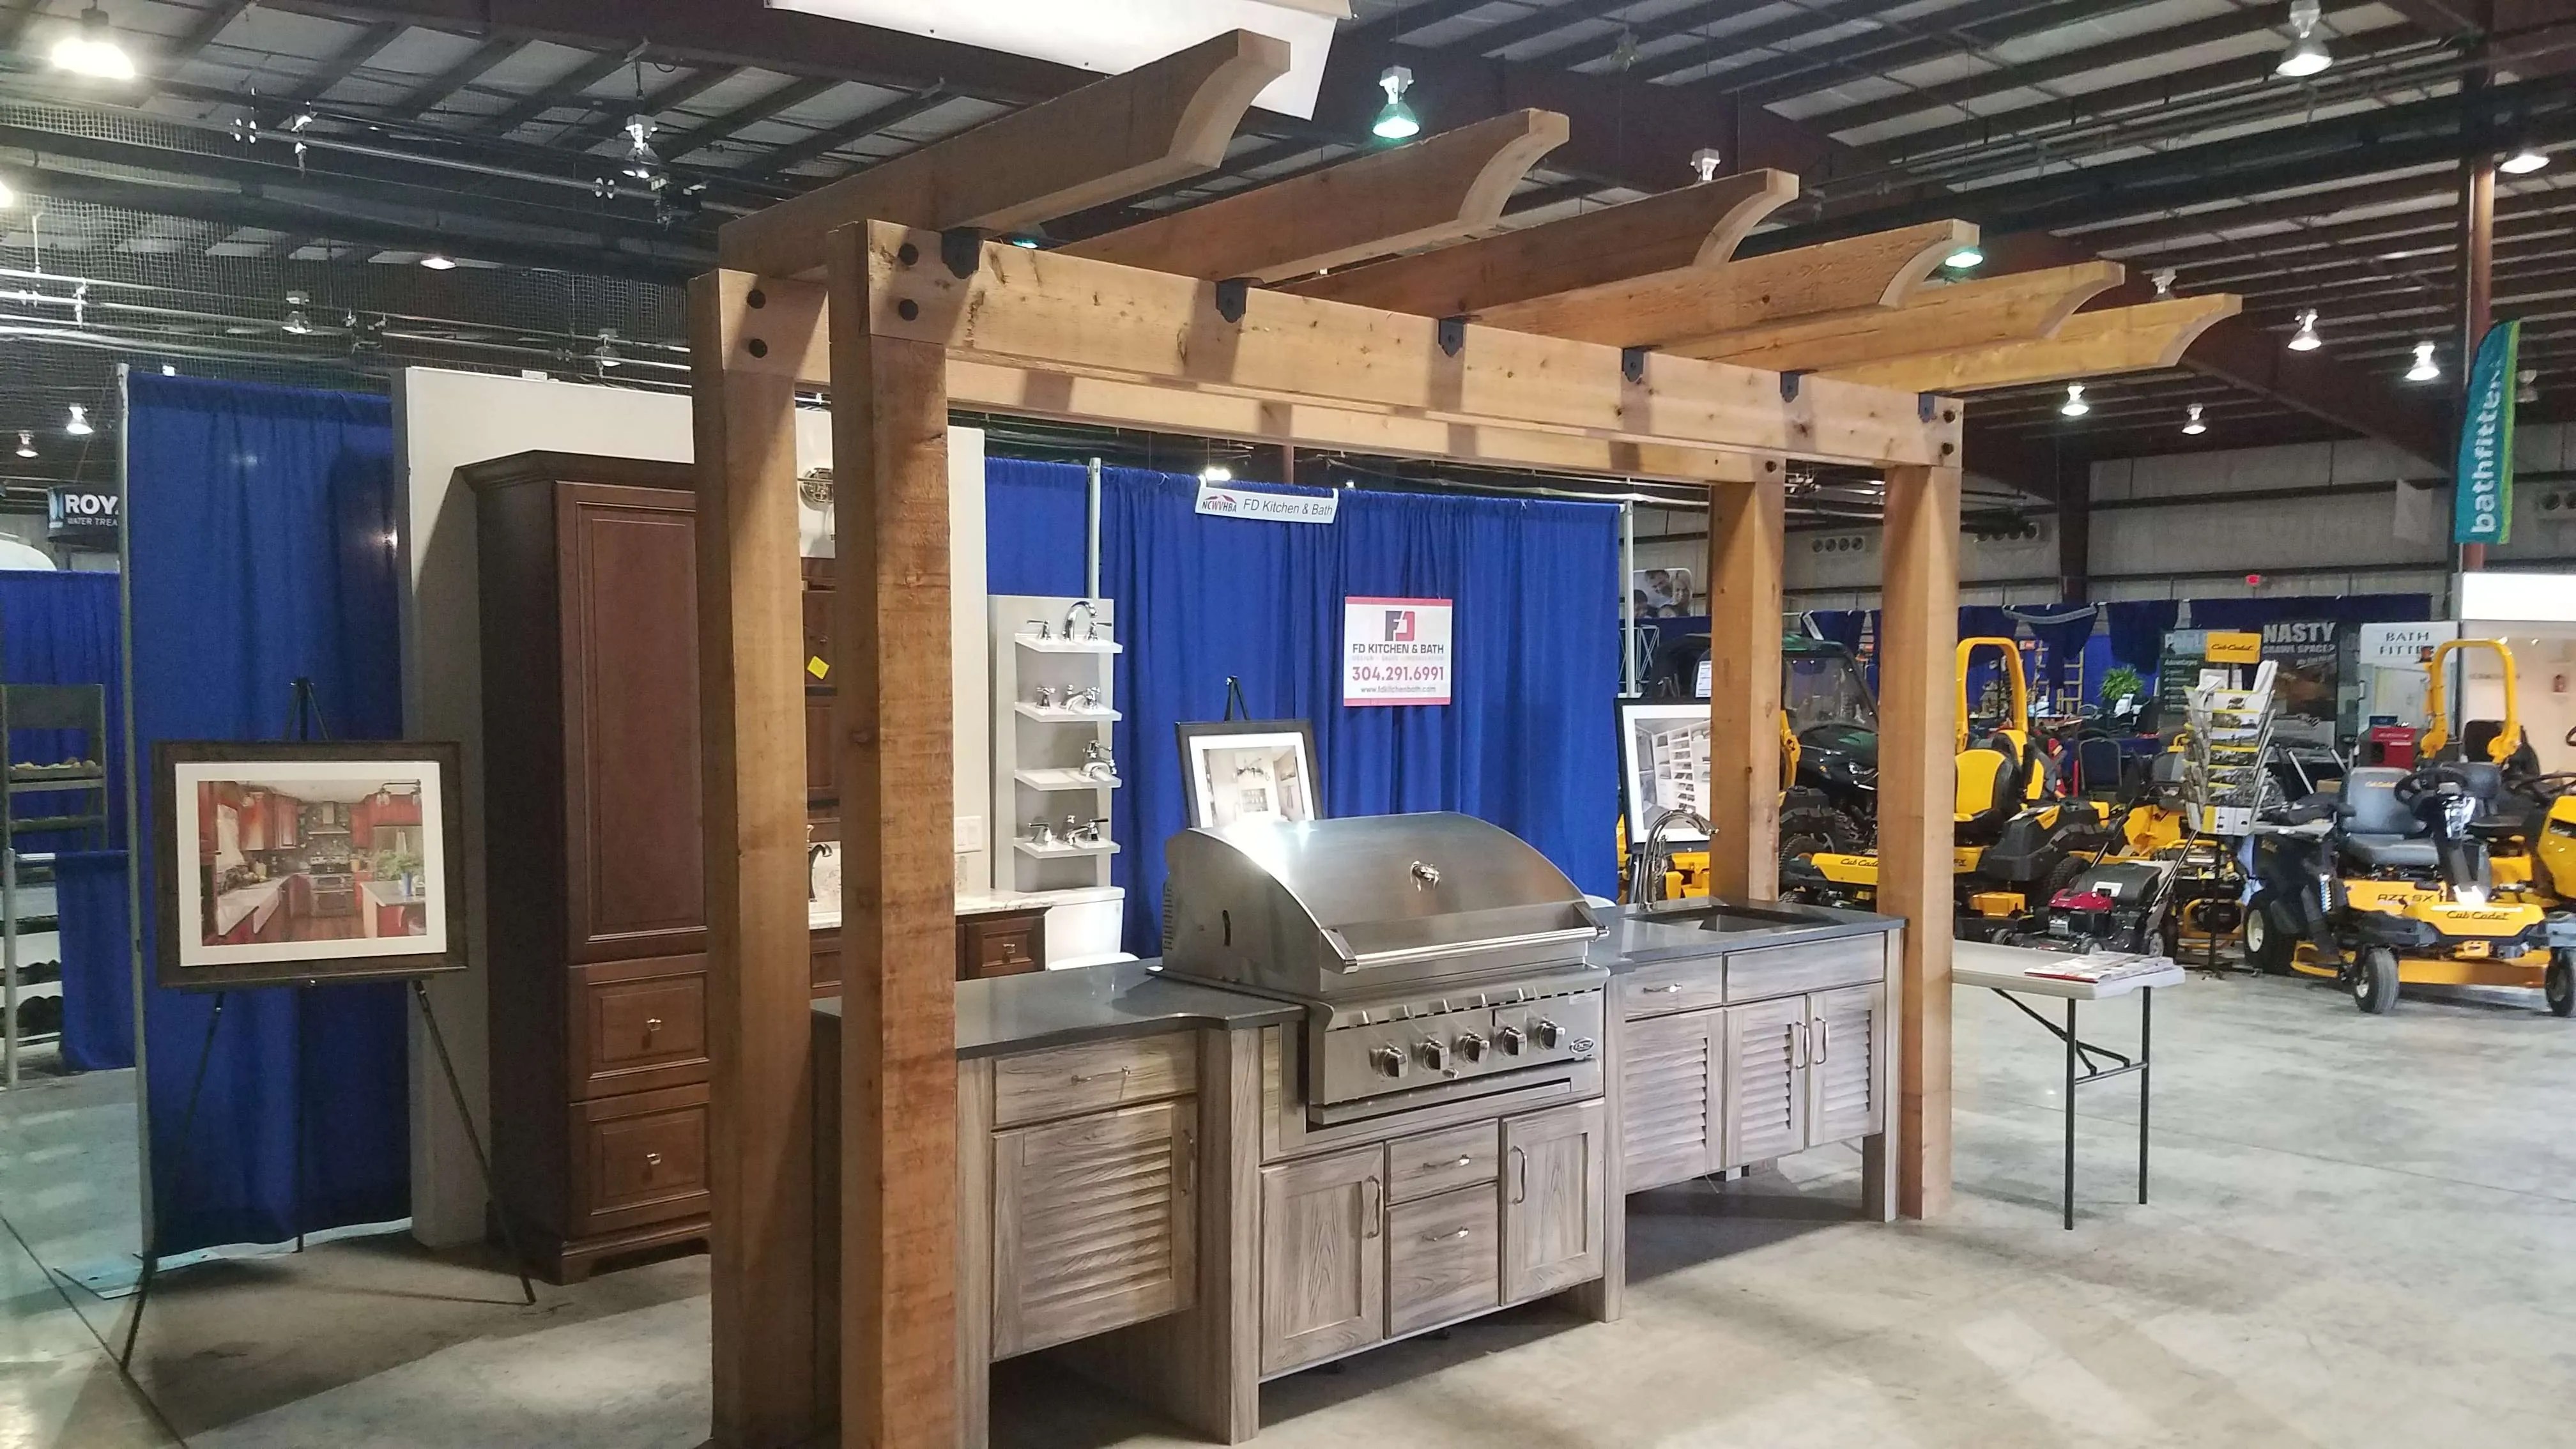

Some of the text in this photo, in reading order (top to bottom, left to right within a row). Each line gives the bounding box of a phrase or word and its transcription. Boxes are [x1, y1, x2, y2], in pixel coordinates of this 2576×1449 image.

[65, 494, 119, 515] ROY
[1243, 499, 1333, 516] FD Kitchen & Bath
[2263, 622, 2336, 643] NASTY
[2386, 632, 2429, 641] BATH
[1353, 643, 1444, 654] FD KITCHEN & BATH
[1352, 666, 1444, 681] 304.291.6991
[2447, 911, 2510, 920] Cub Cadet
